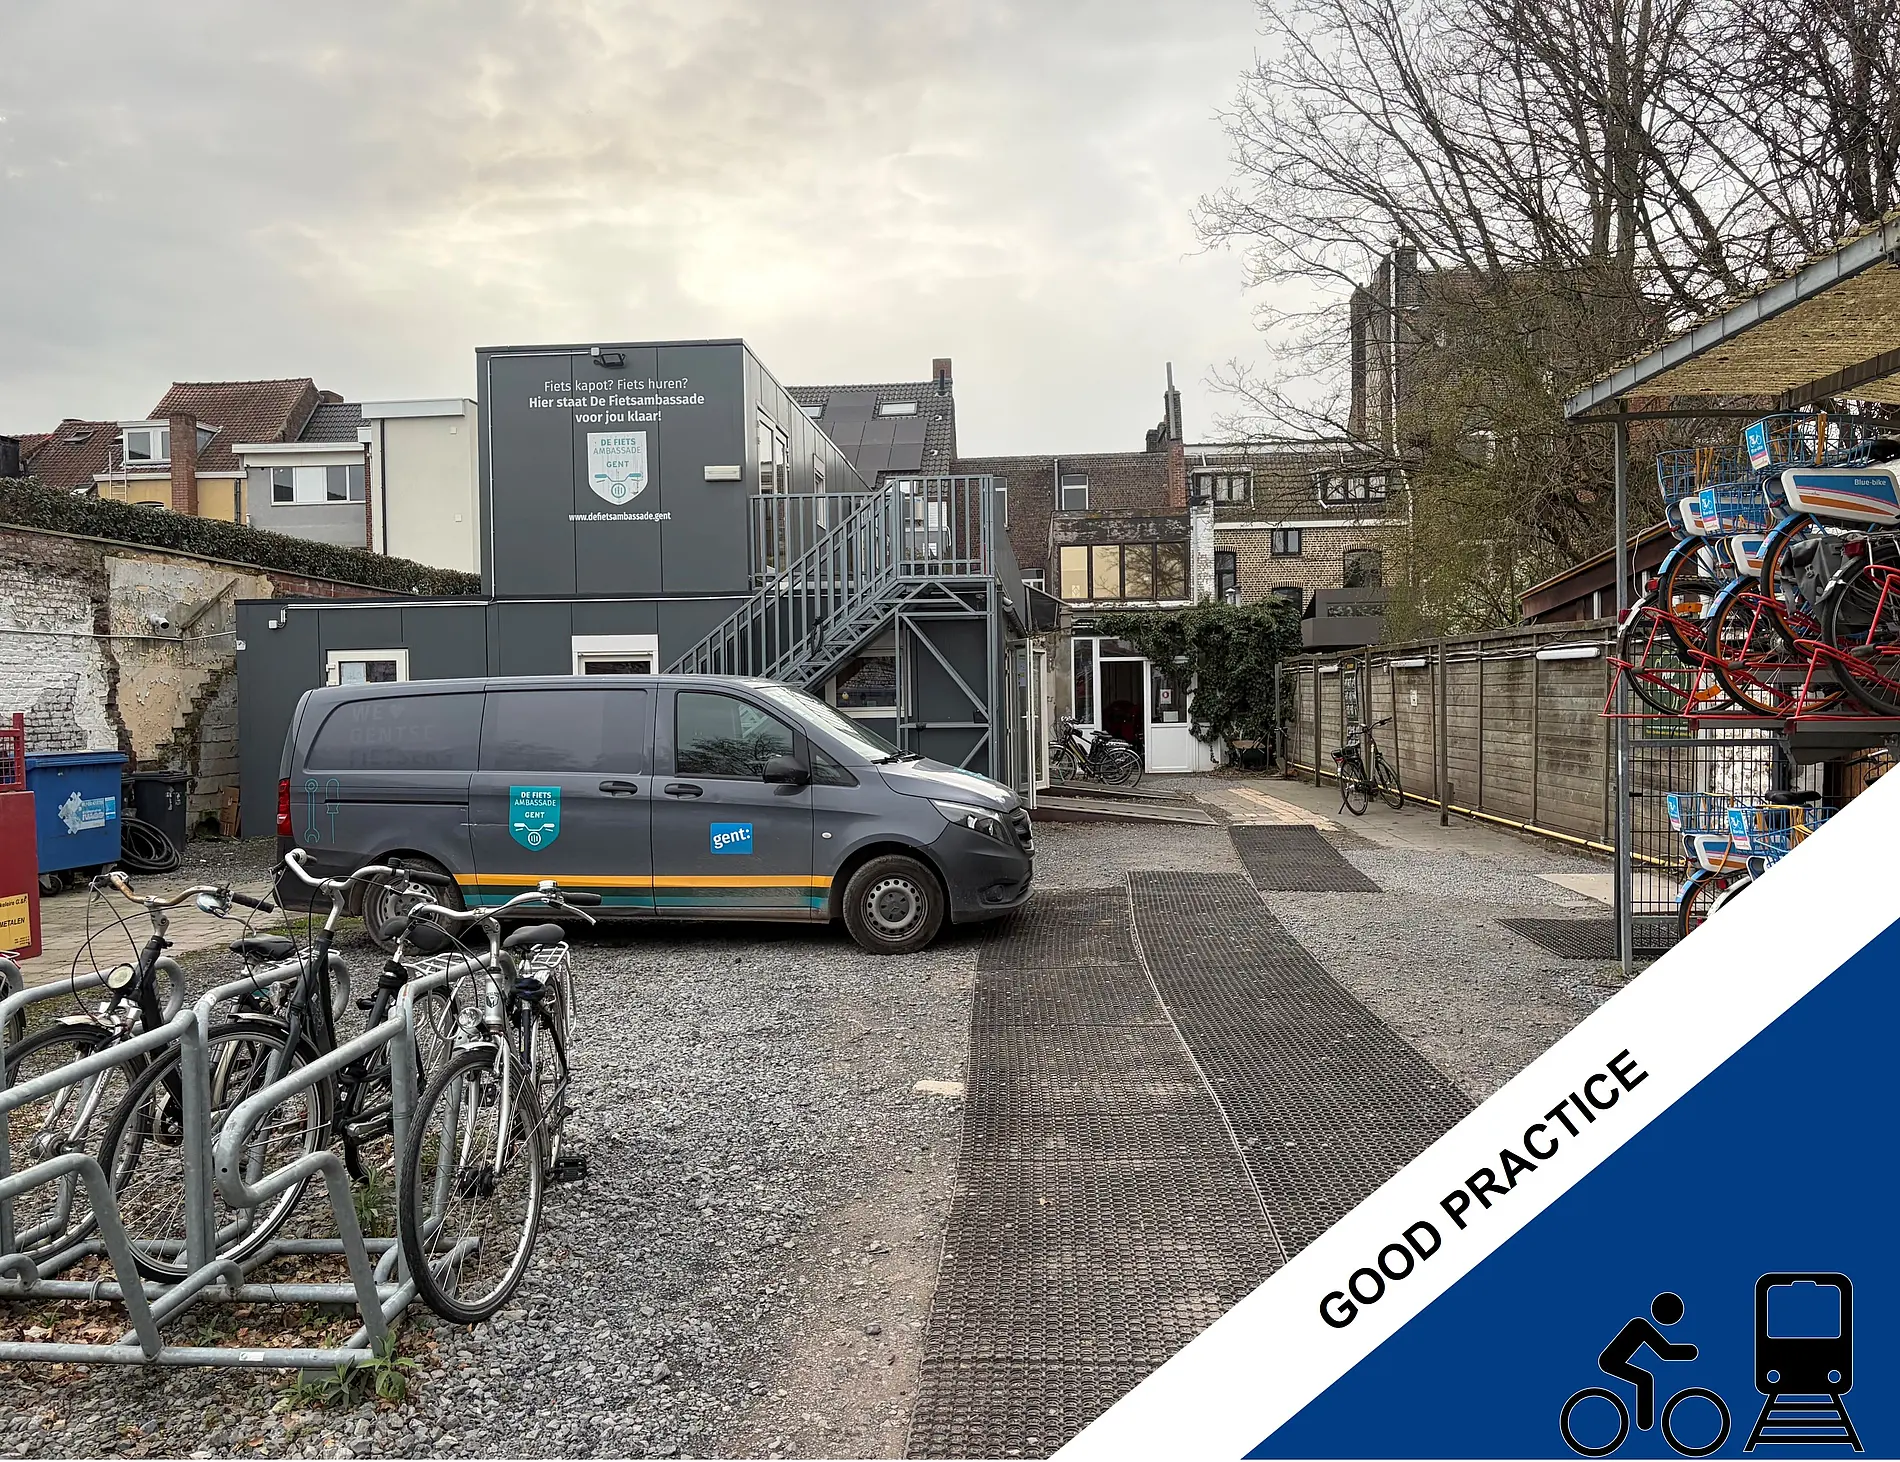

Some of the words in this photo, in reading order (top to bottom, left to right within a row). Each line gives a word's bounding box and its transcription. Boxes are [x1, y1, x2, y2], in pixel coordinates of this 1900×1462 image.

[544, 380, 572, 392] Fiets
[575, 379, 614, 394] kapot?
[617, 378, 645, 390] Fiets
[648, 377, 689, 390] huren?
[529, 395, 554, 408] Hier
[556, 396, 588, 408] staat
[590, 396, 606, 407] De
[609, 393, 705, 406] Fietsambassade
[575, 413, 603, 423] voor
[604, 410, 625, 425] jou
[627, 410, 662, 422] klaar!
[600, 439, 612, 447] DE
[613, 438, 636, 446] FIETS
[593, 446, 641, 455] AMBASSADE
[606, 460, 630, 468] GENT
[1854, 478, 1887, 486] Blue-bike
[568, 511, 672, 522] www.defietsambassade.gent
[521, 791, 531, 799] DE
[532, 791, 552, 799] FIETS
[514, 799, 557, 807] AMBASSADE
[524, 811, 546, 819] GENT
[713, 828, 751, 849] gent:
